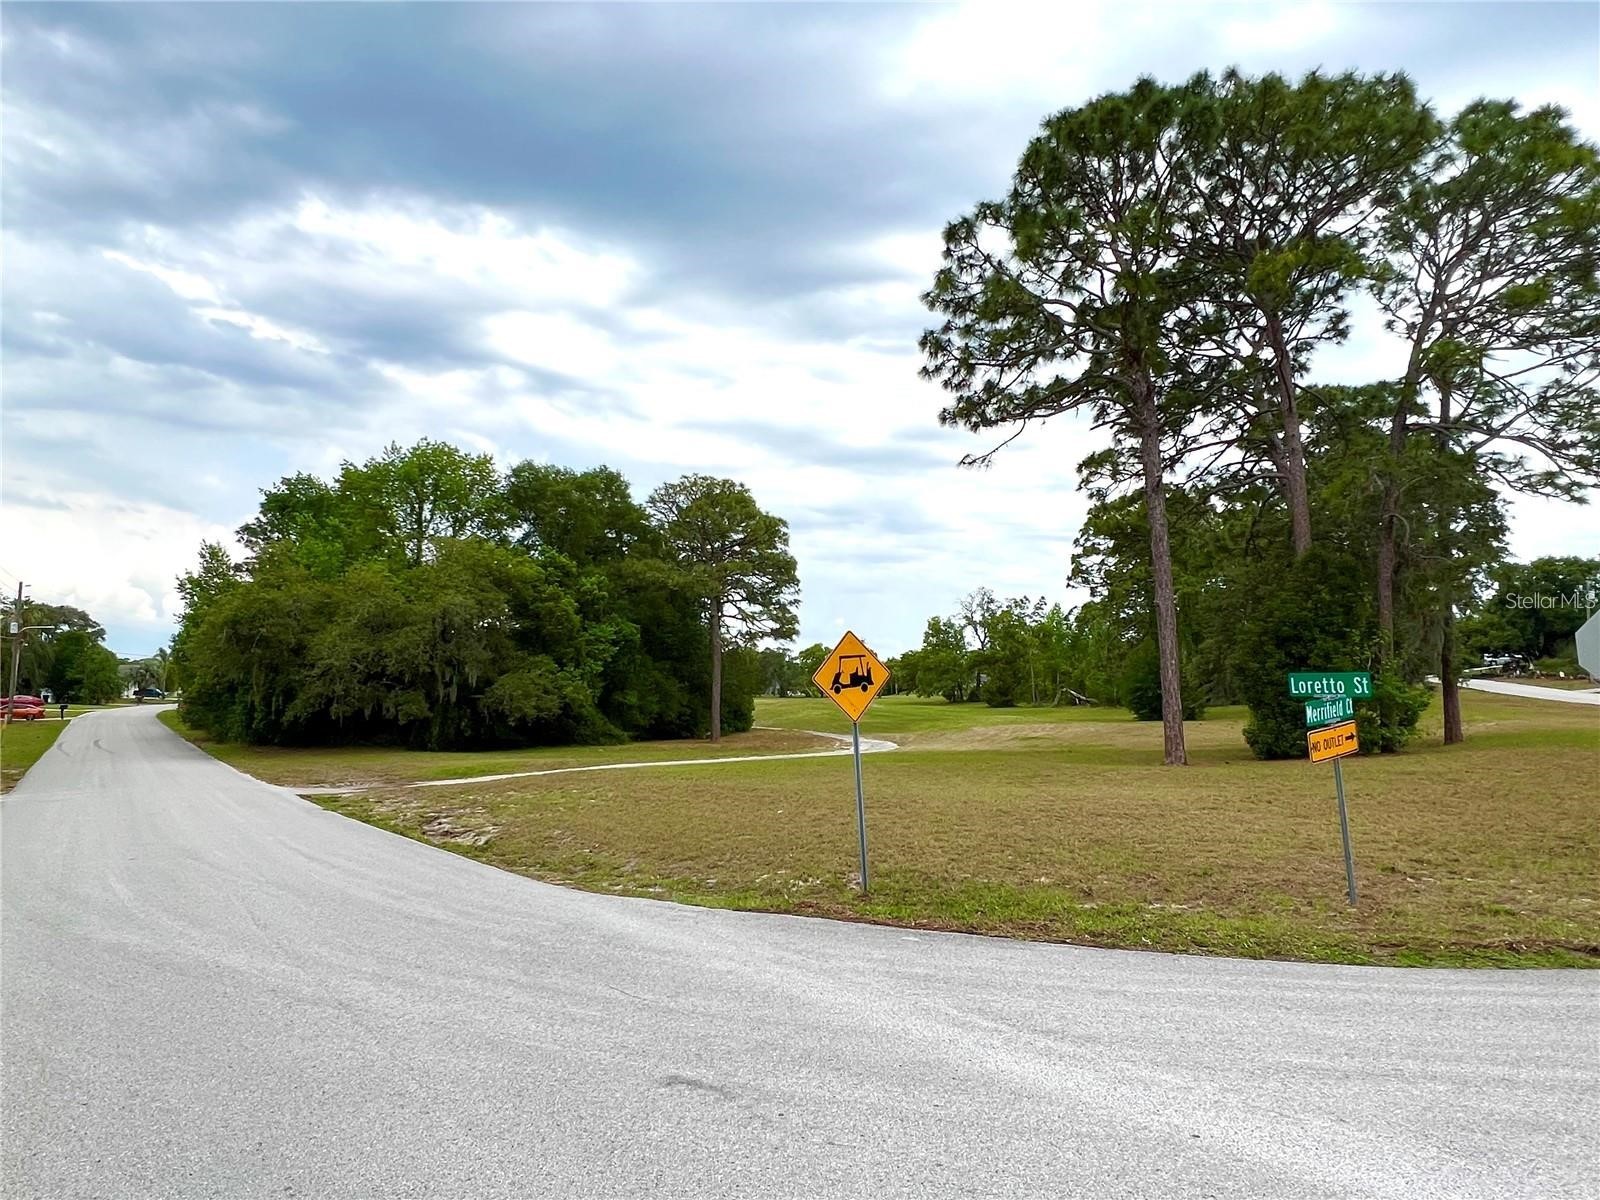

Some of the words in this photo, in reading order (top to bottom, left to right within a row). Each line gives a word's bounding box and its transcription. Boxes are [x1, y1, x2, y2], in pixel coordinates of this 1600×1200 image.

[1291, 677, 1345, 694] Loretto
[1353, 677, 1369, 694] St
[1306, 701, 1343, 723] Merrifield
[1346, 698, 1354, 714] Ct
[1312, 741, 1320, 753] NO
[1323, 735, 1344, 750] OUTLET
